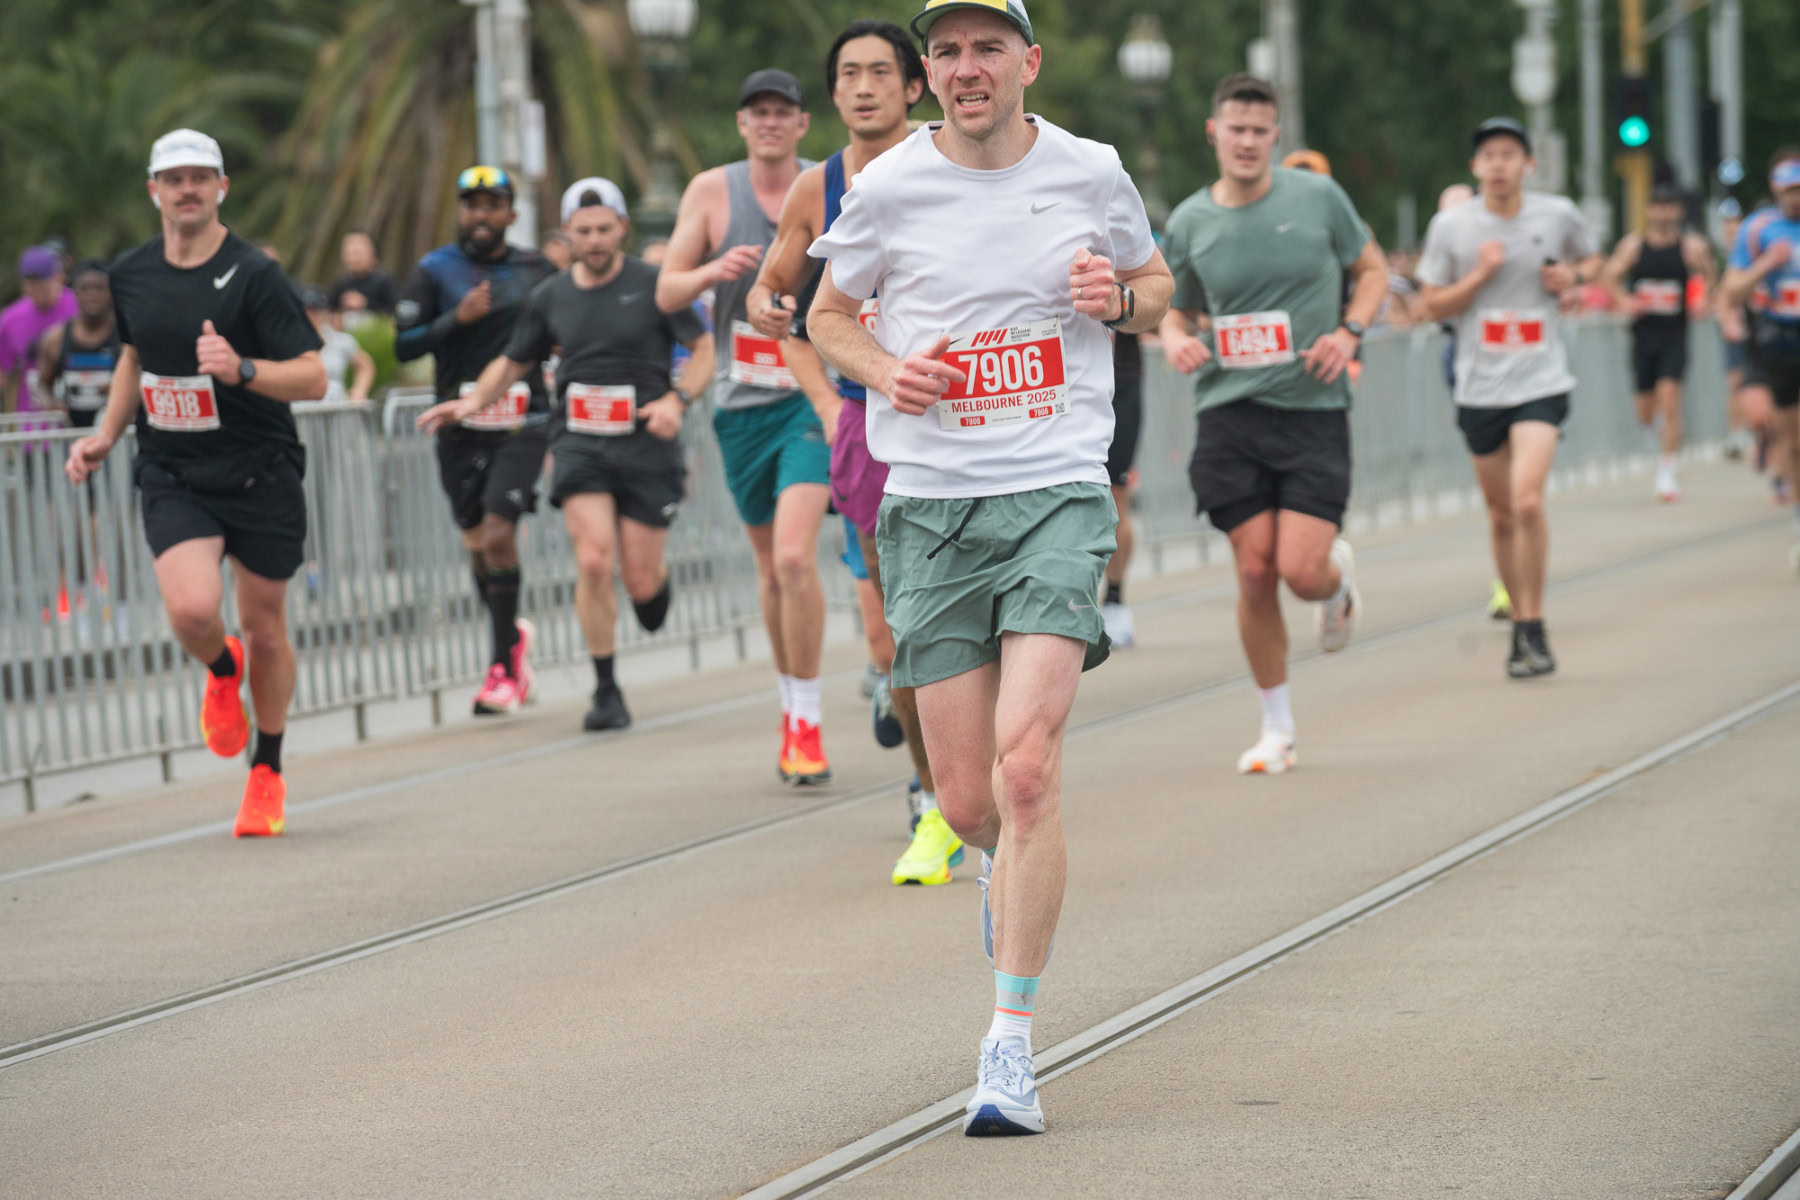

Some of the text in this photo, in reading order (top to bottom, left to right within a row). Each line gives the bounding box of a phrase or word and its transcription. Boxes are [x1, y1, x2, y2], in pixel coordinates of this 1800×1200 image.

[958, 345, 1044, 395] 7906
[152, 389, 200, 417] 9918
[951, 389, 1057, 413] MELBOURNE 2025
[1033, 407, 1049, 417] 7906
[964, 417, 981, 426] 7906
